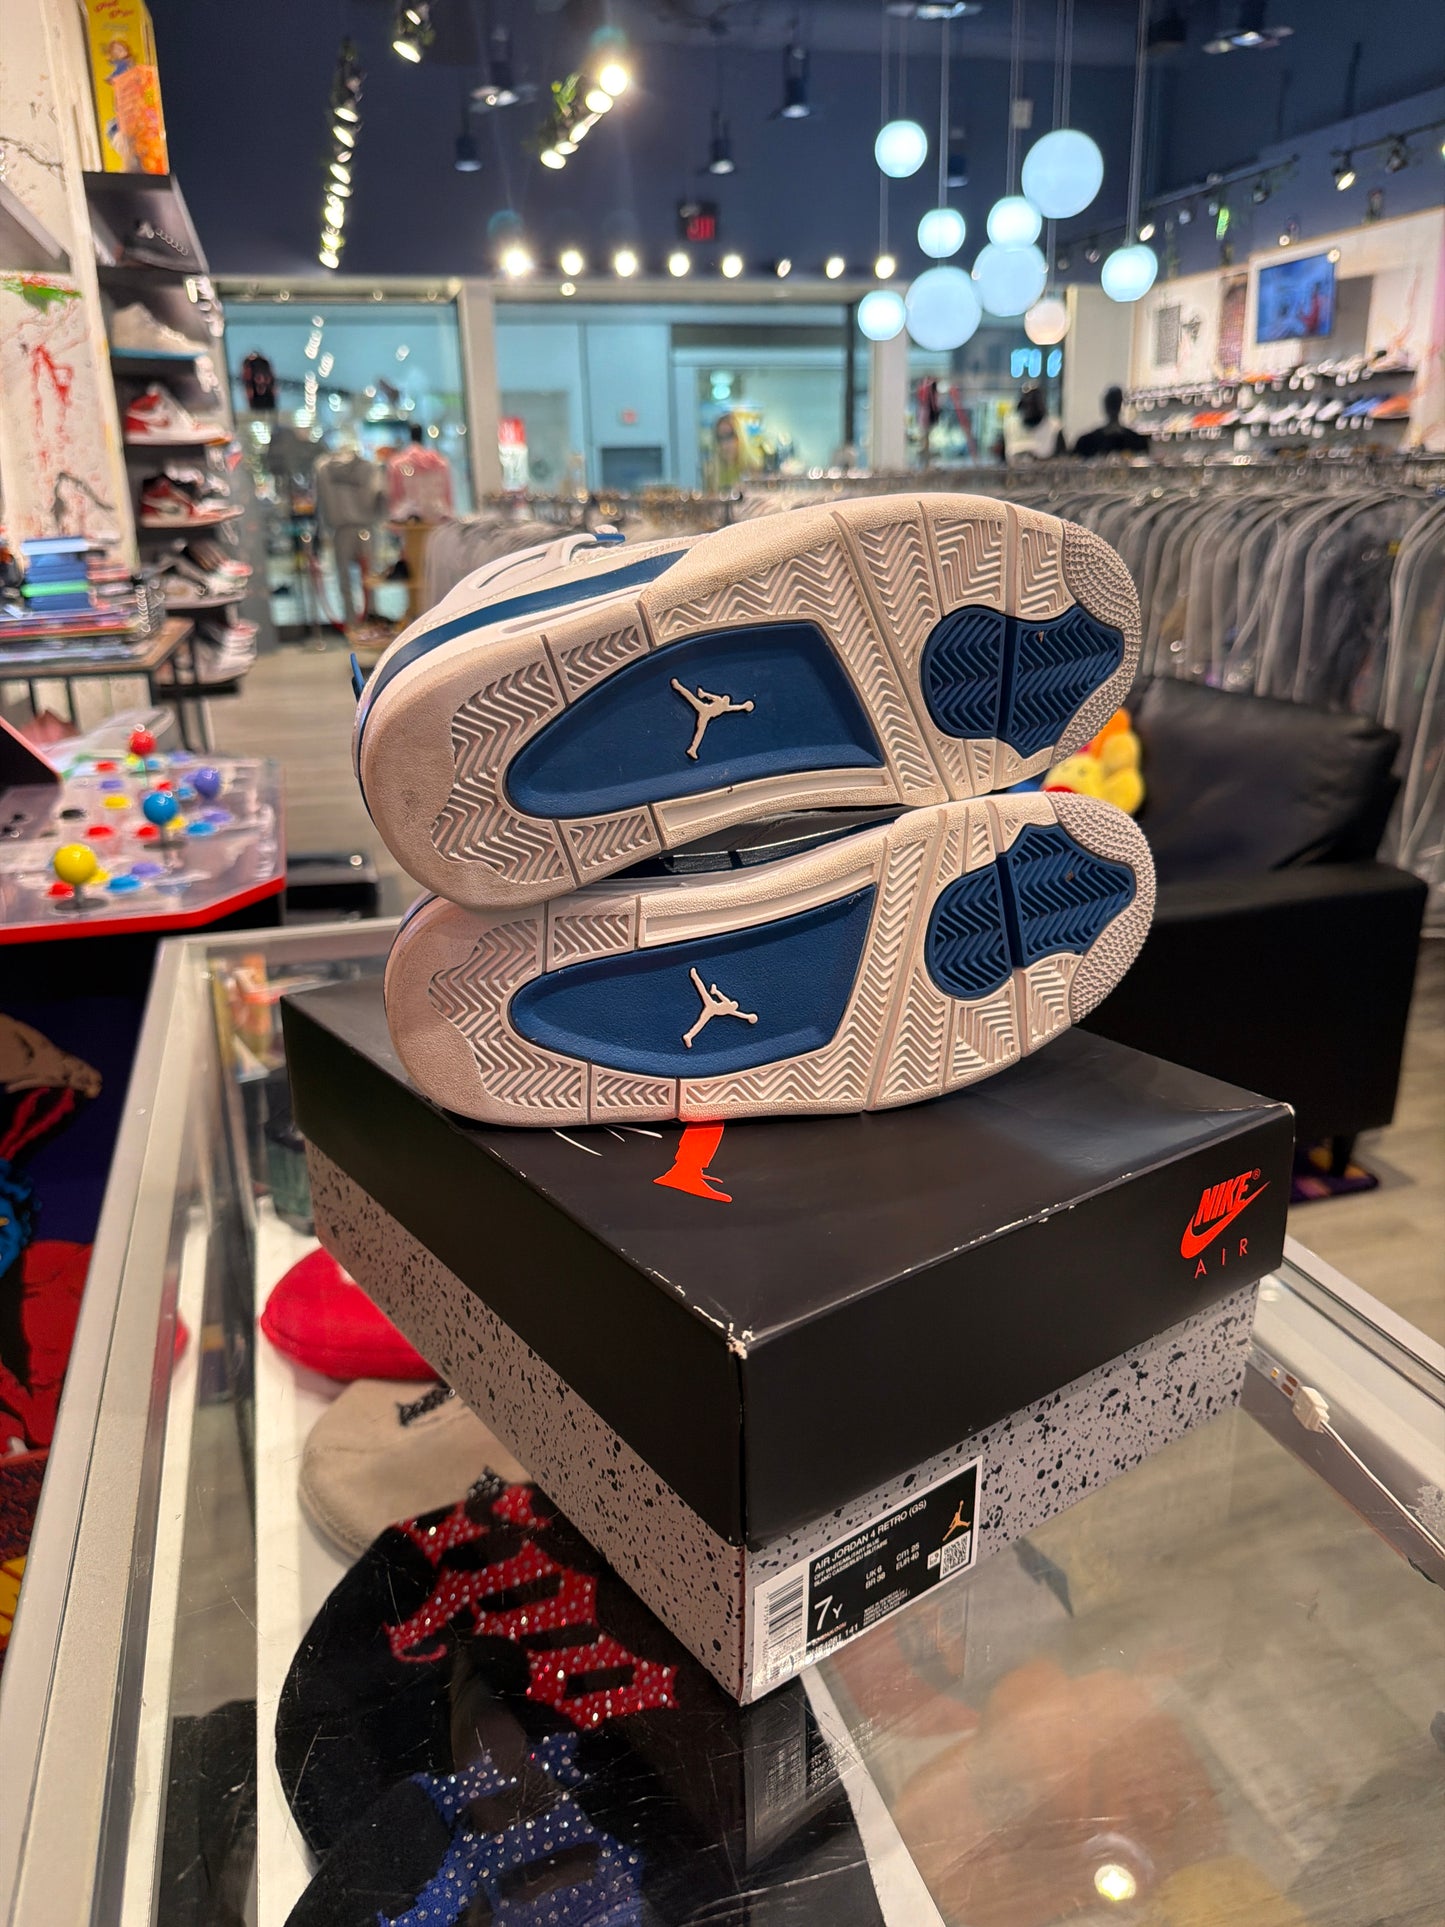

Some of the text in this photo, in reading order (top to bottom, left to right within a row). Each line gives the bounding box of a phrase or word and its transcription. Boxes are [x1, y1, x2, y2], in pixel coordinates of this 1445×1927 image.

[1193, 1170, 1253, 1228] NIKE
[1194, 1237, 1249, 1280] AIR
[814, 1499, 927, 1573] AIR JORDAN 4 RETRO (GS)
[895, 1557, 910, 1571] EUR
[910, 1551, 920, 1561] 40
[896, 1548, 910, 1562] cm
[865, 1568, 877, 1580] UK
[865, 1578, 876, 1590] BR
